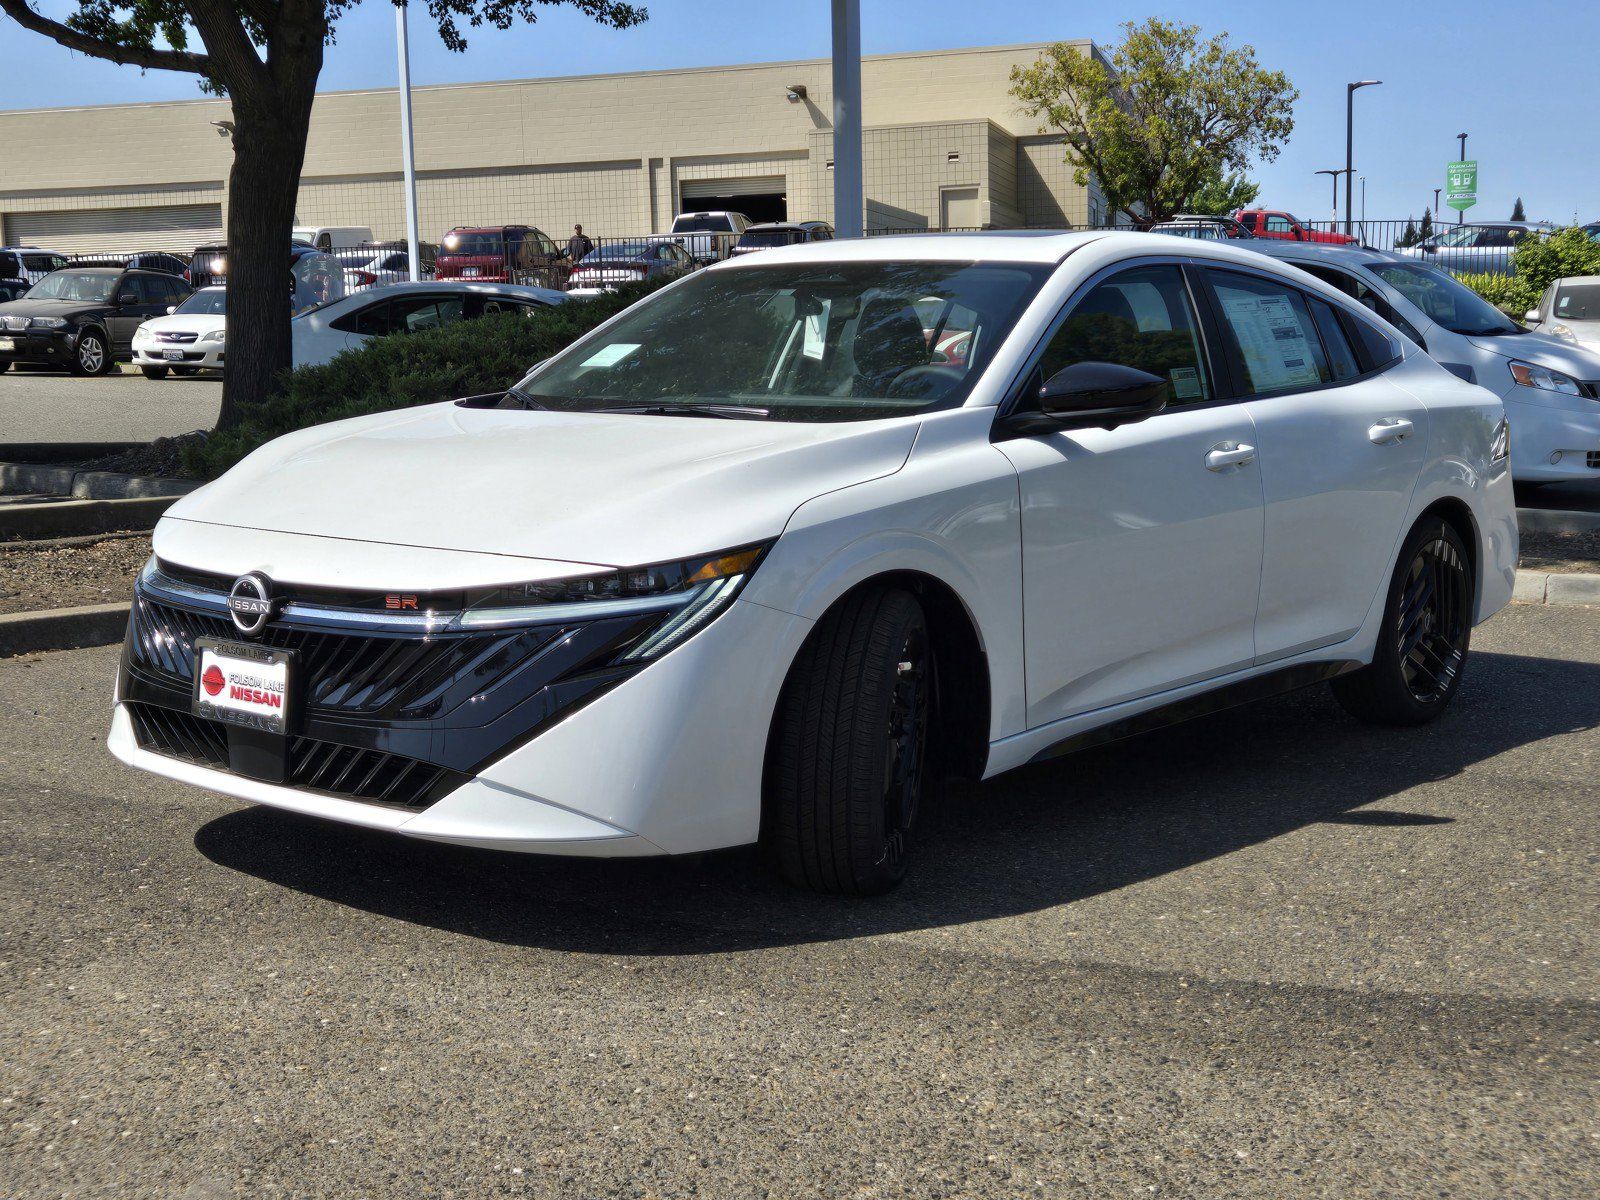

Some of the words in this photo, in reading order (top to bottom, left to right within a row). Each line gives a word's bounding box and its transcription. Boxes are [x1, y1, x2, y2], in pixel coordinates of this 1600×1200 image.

[227, 597, 270, 613] NISSAN
[385, 594, 419, 610] SR
[228, 671, 262, 689] FOLSOM
[263, 679, 285, 693] LAKE
[229, 685, 282, 708] NISSAN
[214, 704, 264, 729] NISSAN
